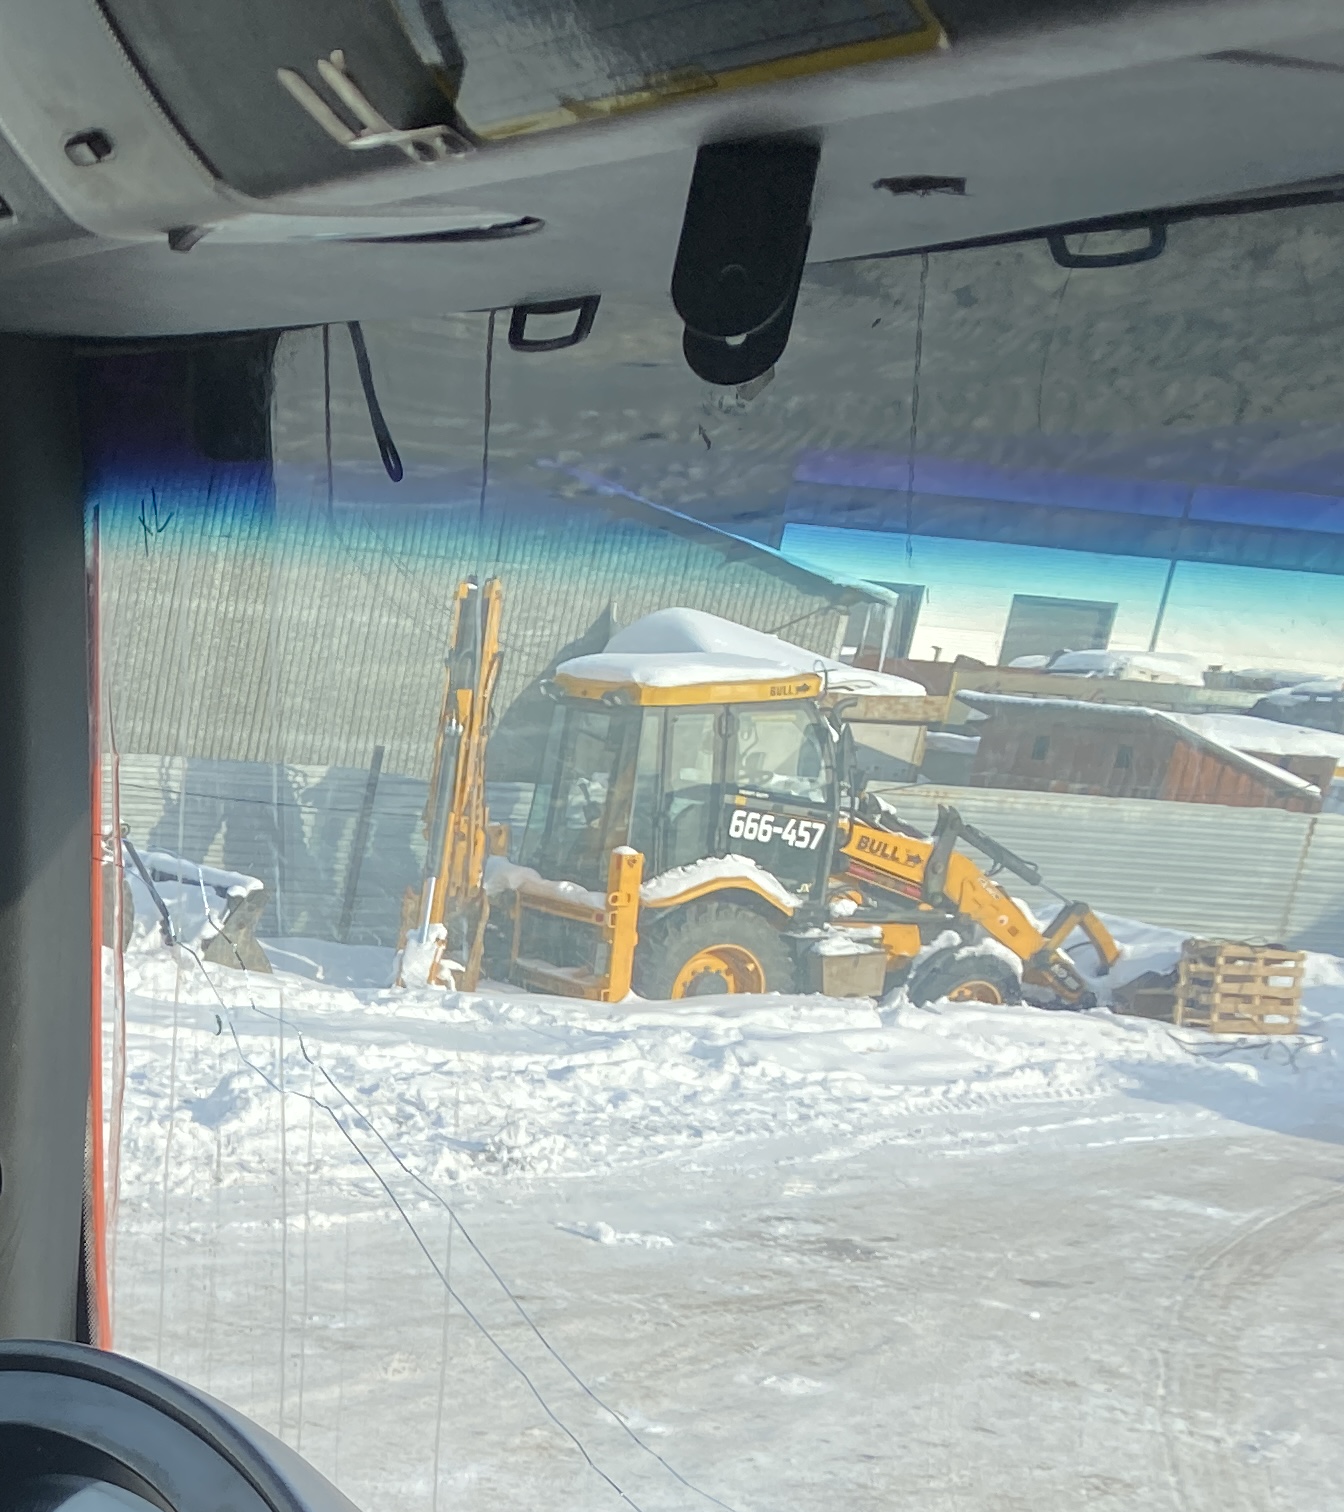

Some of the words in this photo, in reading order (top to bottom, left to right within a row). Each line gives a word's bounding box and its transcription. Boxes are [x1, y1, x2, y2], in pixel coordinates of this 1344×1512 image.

[769, 683, 795, 698] BULL
[728, 808, 827, 851] 666-457
[855, 835, 901, 863] BULL
